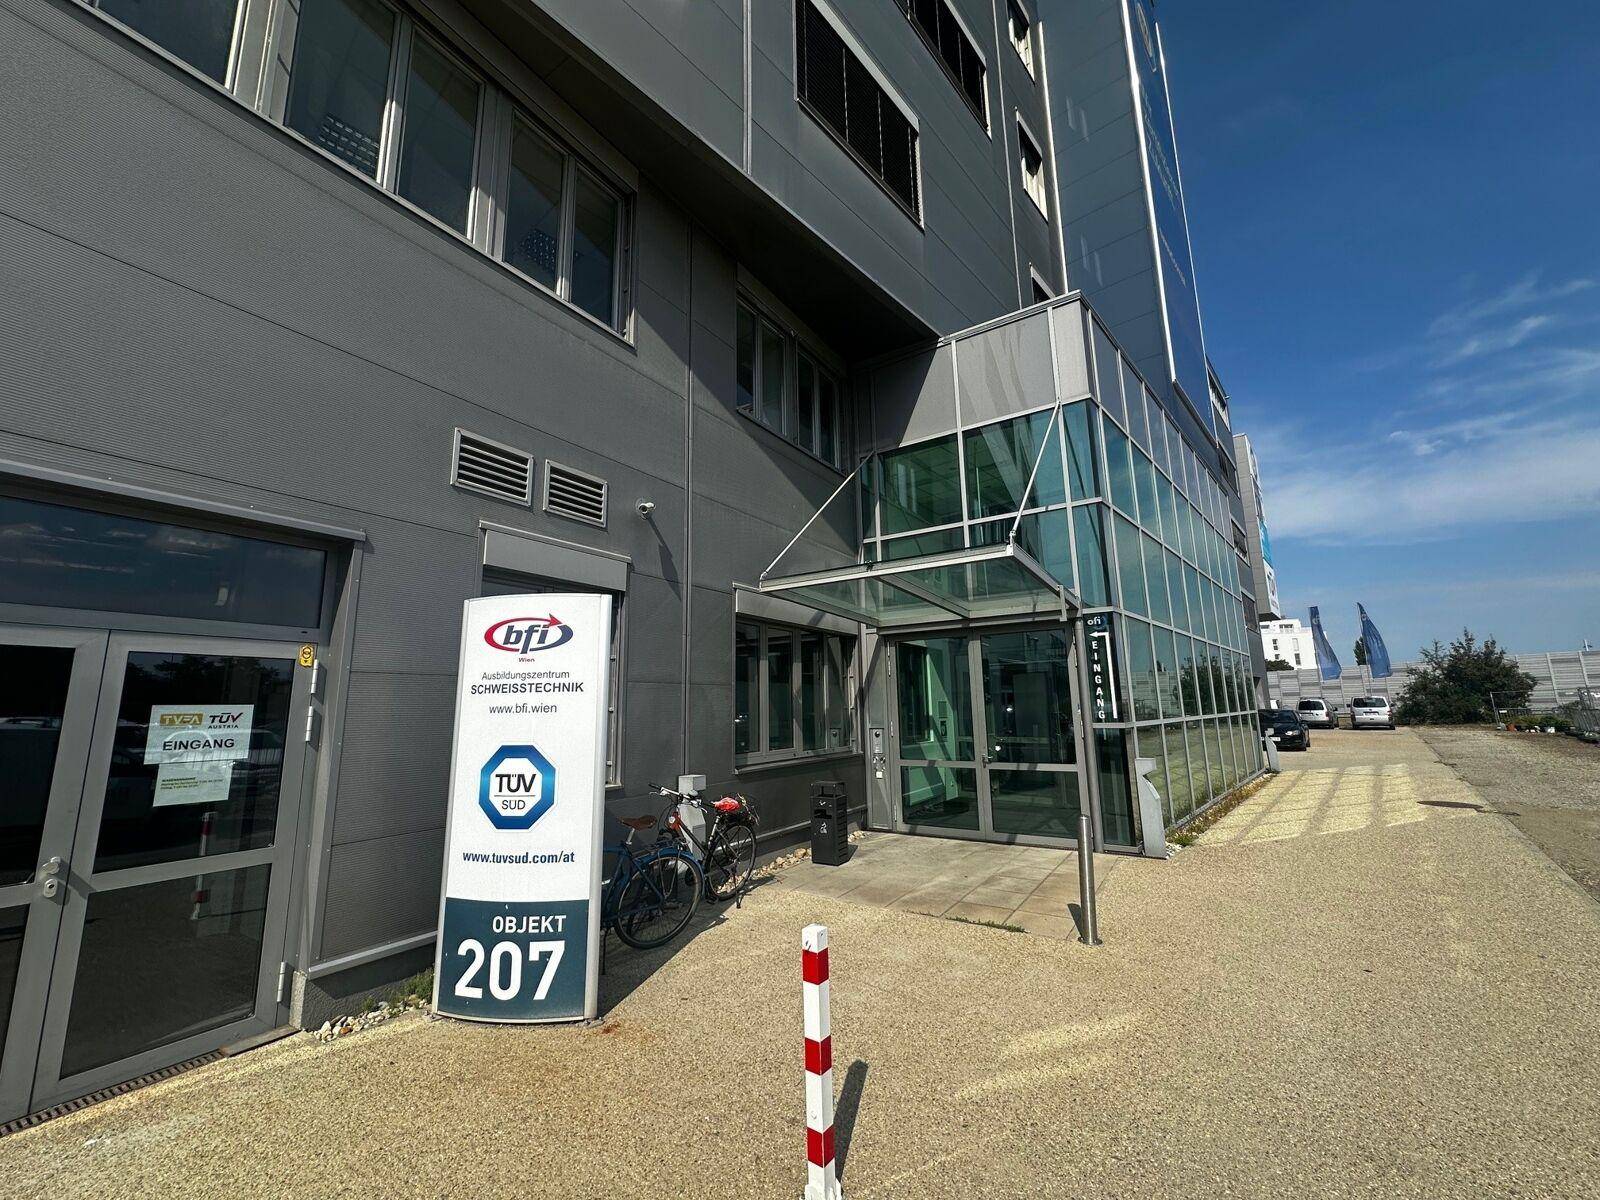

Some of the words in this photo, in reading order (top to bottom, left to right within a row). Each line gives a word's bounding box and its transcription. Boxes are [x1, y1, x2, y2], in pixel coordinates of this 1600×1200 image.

[503, 624, 550, 654] bfi
[481, 671, 570, 681] Ausbildungszentrum
[1091, 640, 1106, 719] EINGANG
[470, 682, 584, 695] SCHWEISSTECHNIK
[489, 702, 558, 714] www.bfi.wien
[162, 738, 235, 751] EINGANG
[495, 773, 537, 793] TÜV
[462, 850, 576, 864] www.tuvsud.com/at
[492, 914, 567, 934] OBJEKT
[454, 938, 566, 1001] 207
